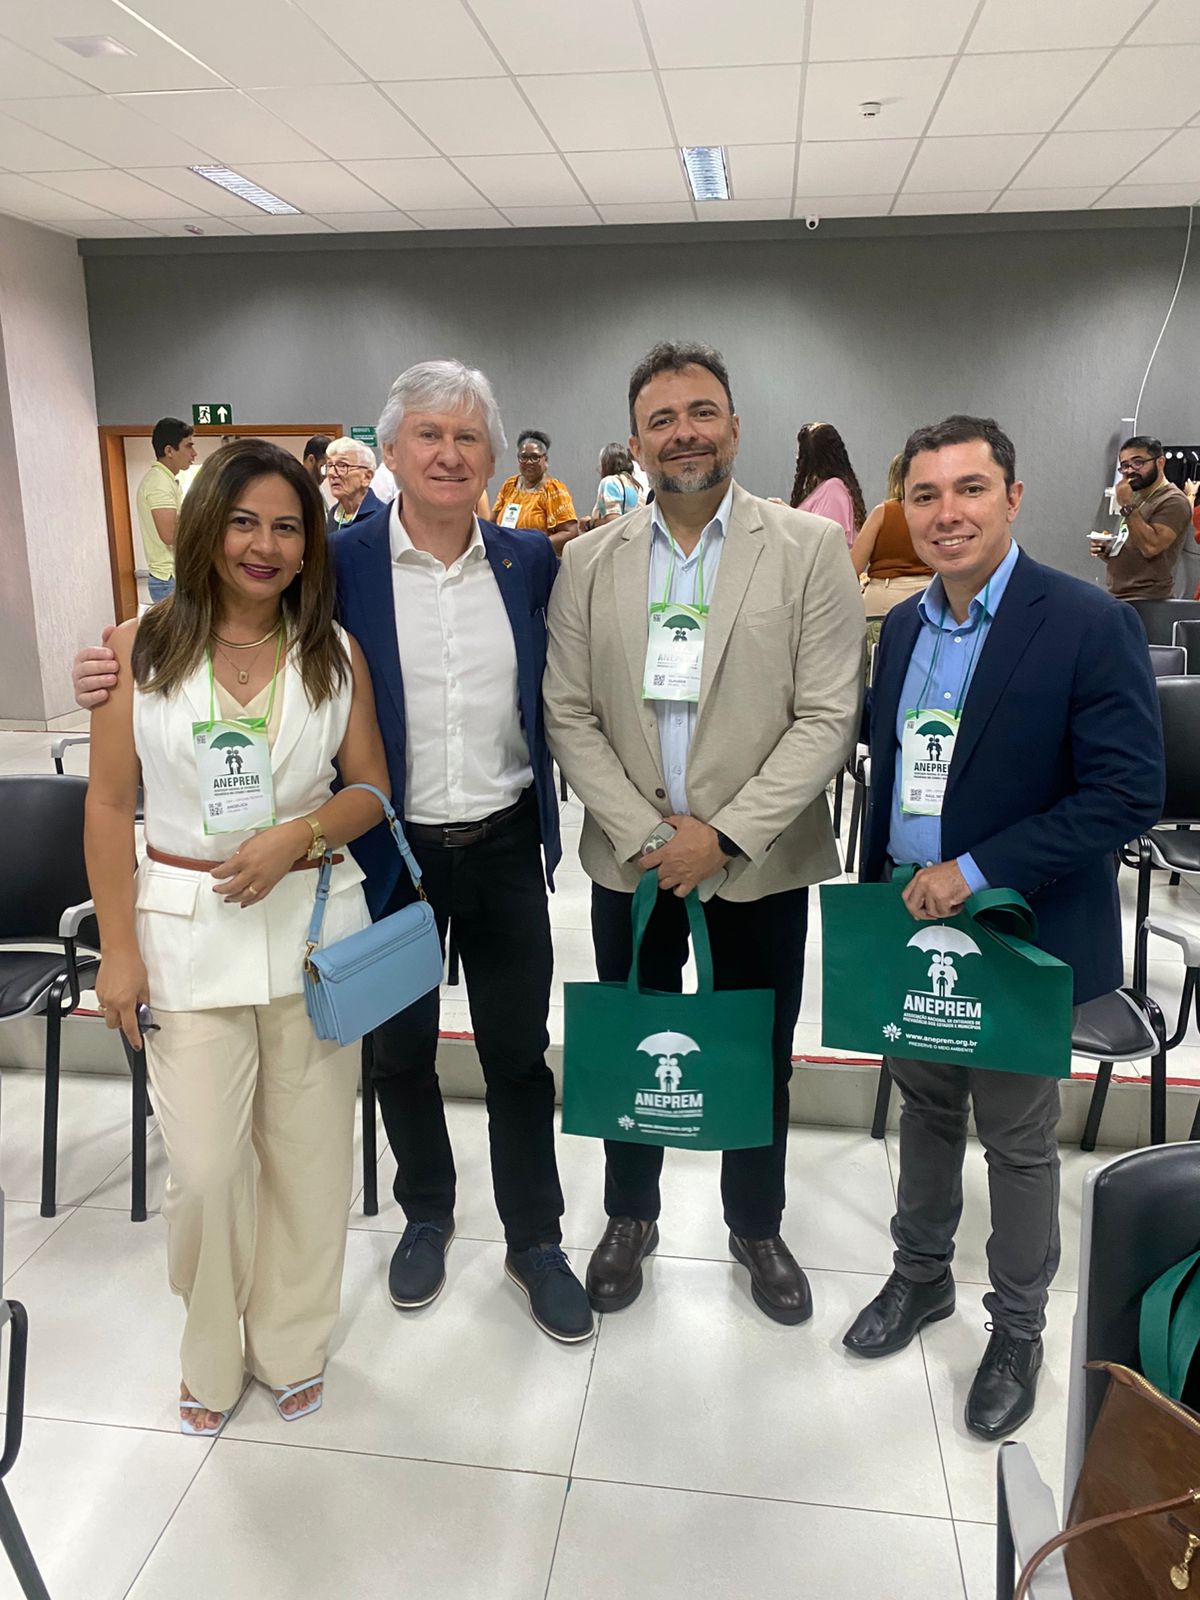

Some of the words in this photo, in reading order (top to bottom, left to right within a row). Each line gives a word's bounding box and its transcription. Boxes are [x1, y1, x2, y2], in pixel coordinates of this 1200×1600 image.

[914, 762, 949, 773] ANEPRE
[214, 775, 260, 788] ANEPREM
[903, 994, 982, 1018] ANEPREM
[905, 1033, 978, 1047] www.aneprem.org.br
[908, 1041, 933, 1049] PRESERVE
[635, 1092, 703, 1108] ANEPREM
